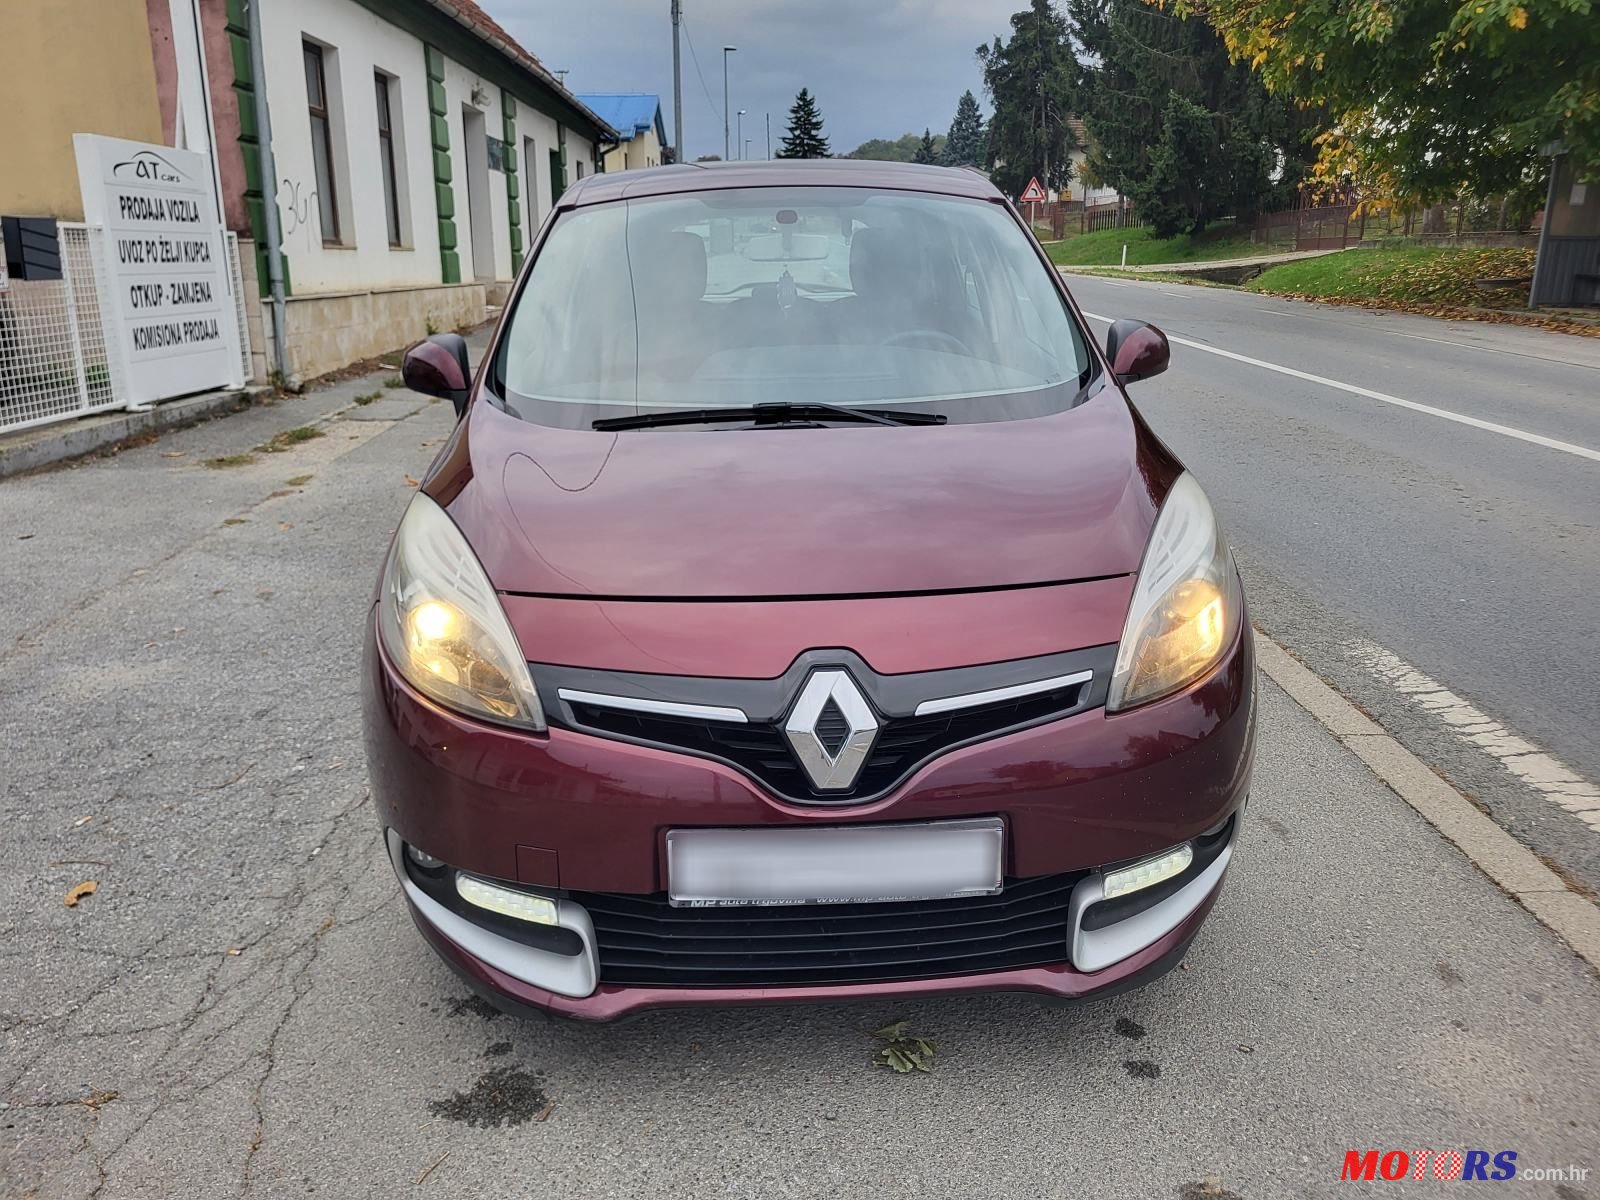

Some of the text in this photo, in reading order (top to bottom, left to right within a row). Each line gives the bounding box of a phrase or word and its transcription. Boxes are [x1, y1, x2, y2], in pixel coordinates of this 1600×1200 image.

[161, 173, 181, 183] cars
[119, 195, 201, 223] PRODAJA VOZILA
[118, 239, 144, 264] UVOZ
[146, 240, 159, 264] PO
[184, 240, 212, 263] KUPCA
[130, 284, 163, 308] OTKUP
[170, 281, 213, 305] ZAMJENA
[133, 318, 221, 351] KOMISIONA PRODAJA
